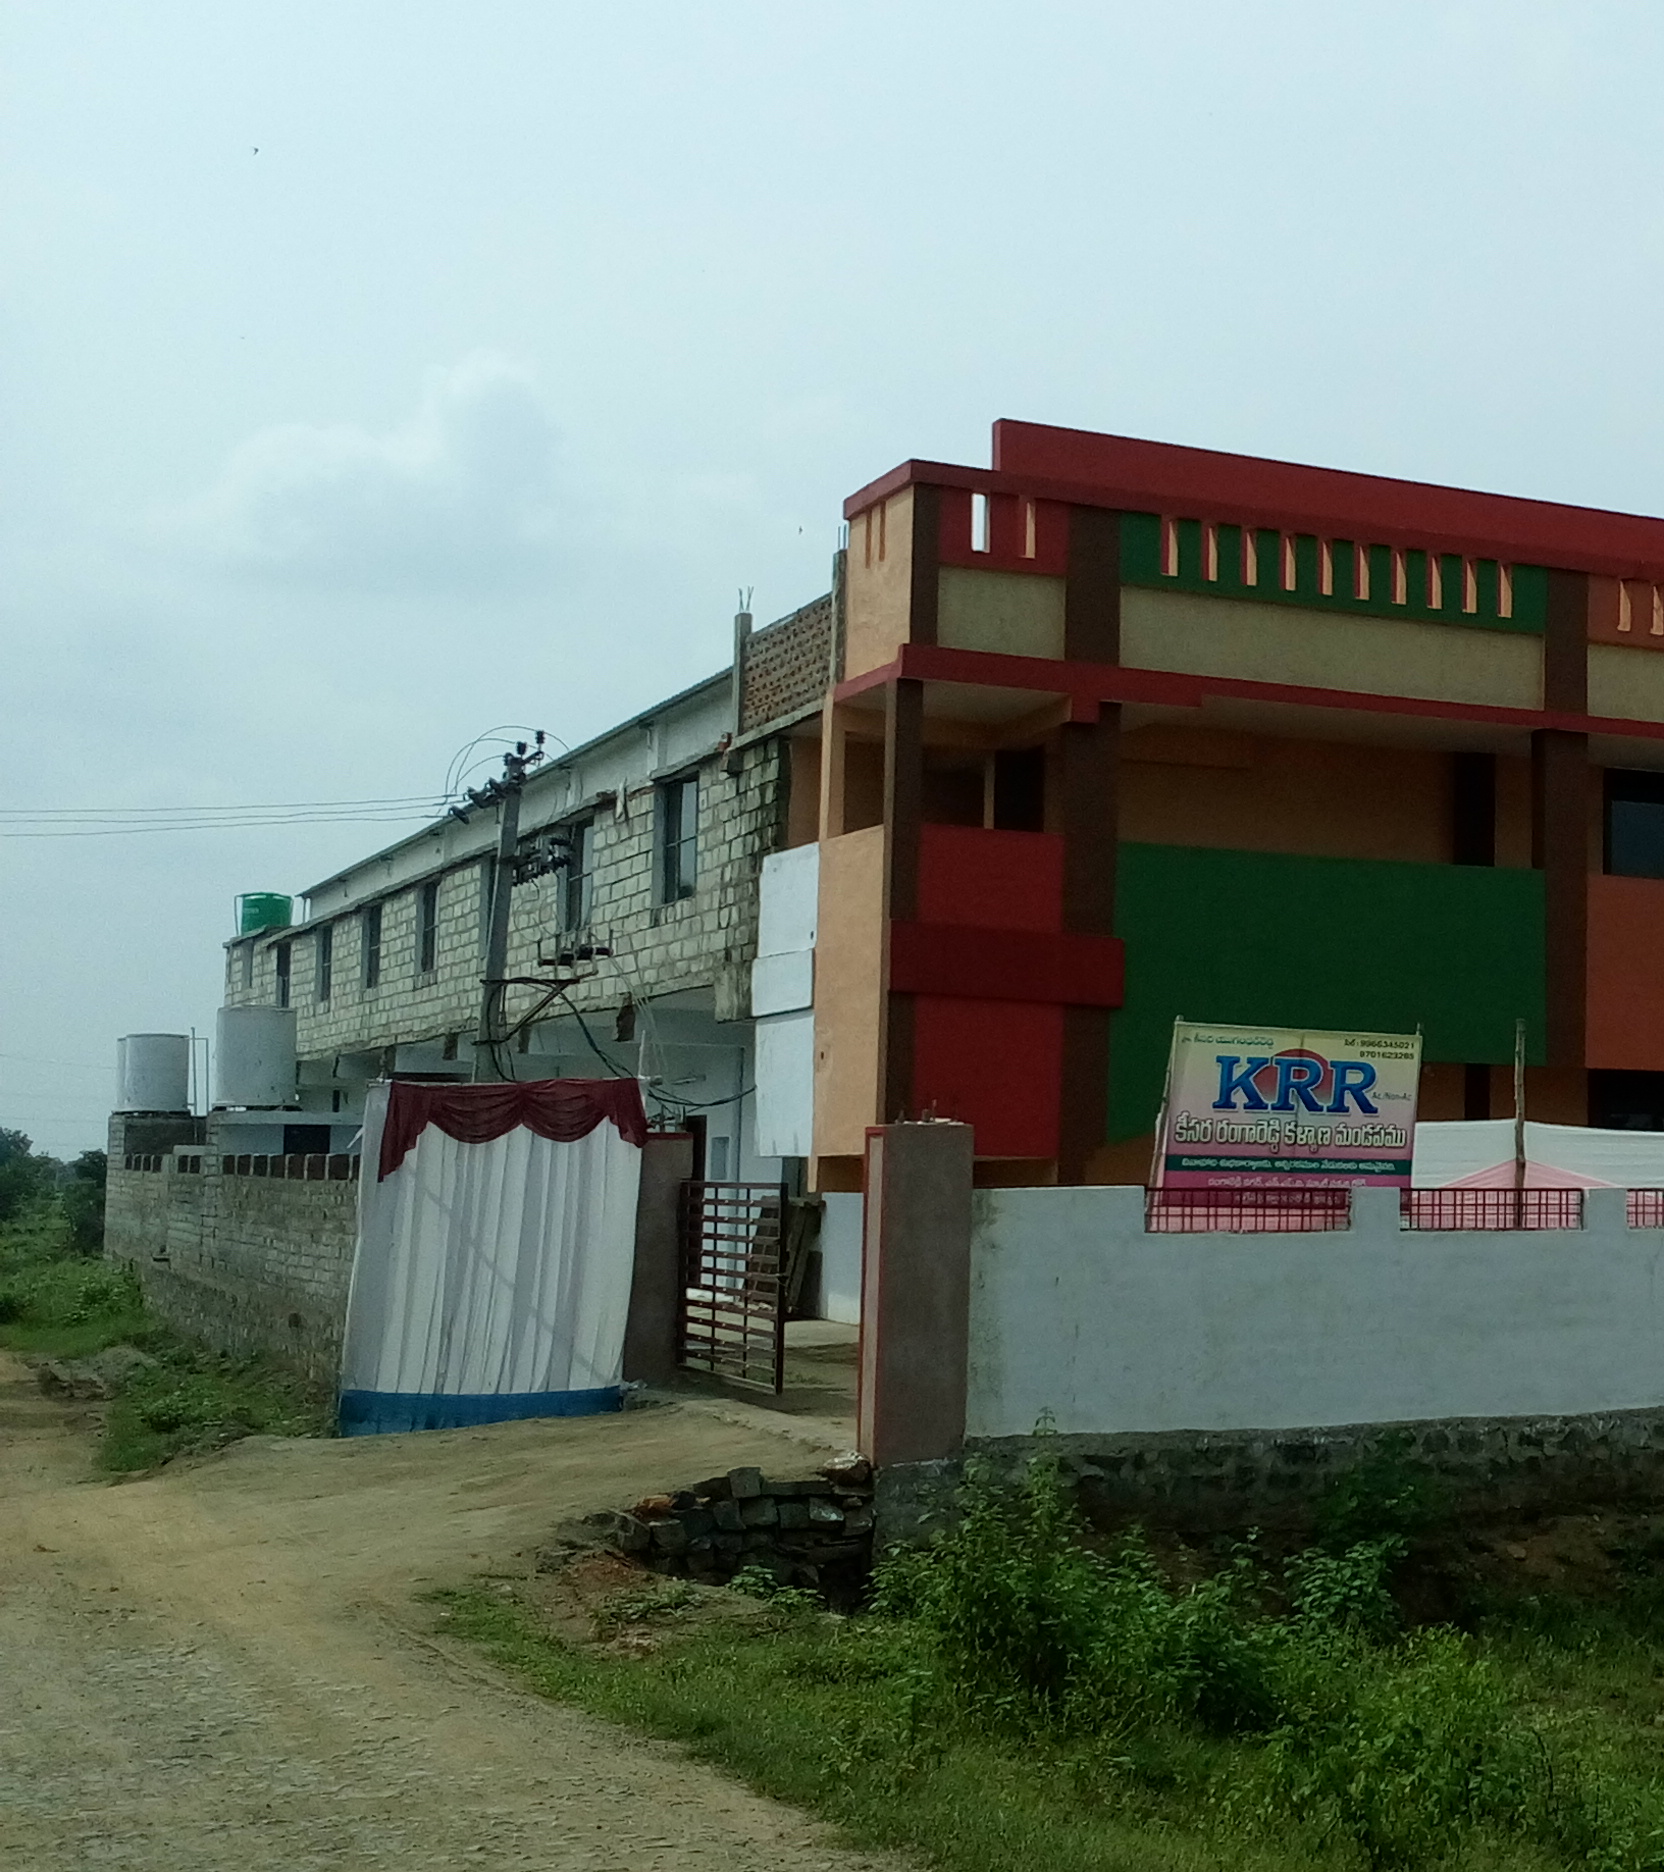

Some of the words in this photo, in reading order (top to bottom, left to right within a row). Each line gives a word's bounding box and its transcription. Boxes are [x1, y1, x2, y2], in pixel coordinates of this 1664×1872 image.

[1212, 1055, 1379, 1114] KRR
[1174, 1110, 1213, 1144] కీసర
[1215, 1117, 1281, 1153] రంగారెడ్డి
[1283, 1120, 1331, 1152] కళ్యాణ
[1335, 1122, 1408, 1149] మండపము
